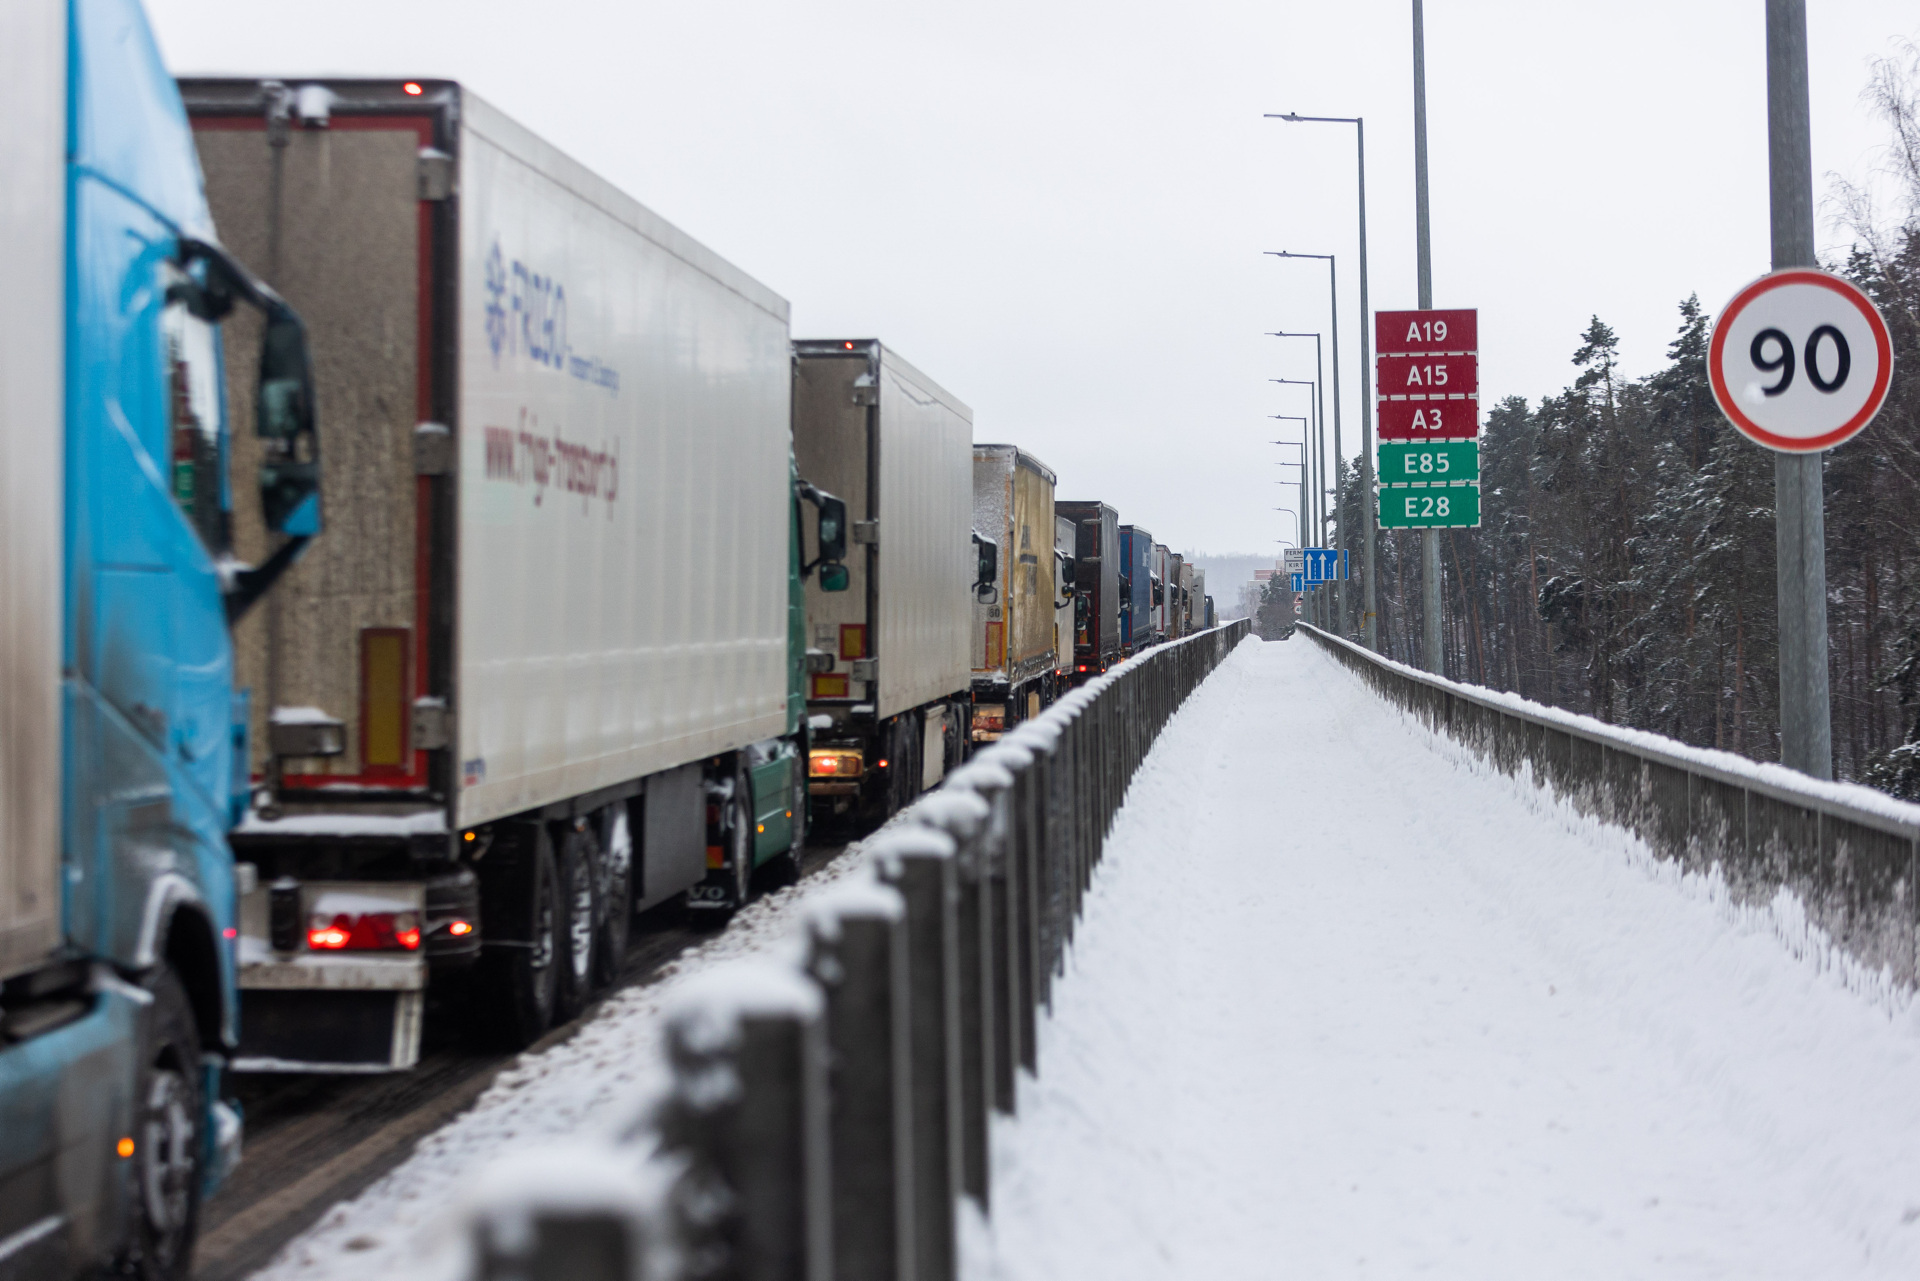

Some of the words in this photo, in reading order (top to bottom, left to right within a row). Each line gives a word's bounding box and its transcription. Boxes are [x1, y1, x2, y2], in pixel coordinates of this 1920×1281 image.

[1405, 320, 1448, 342] A19
[1749, 323, 1851, 398] 90
[1406, 364, 1449, 386] A15
[1411, 408, 1443, 430] A3
[1404, 452, 1450, 474] E85
[1405, 496, 1451, 518] E28
